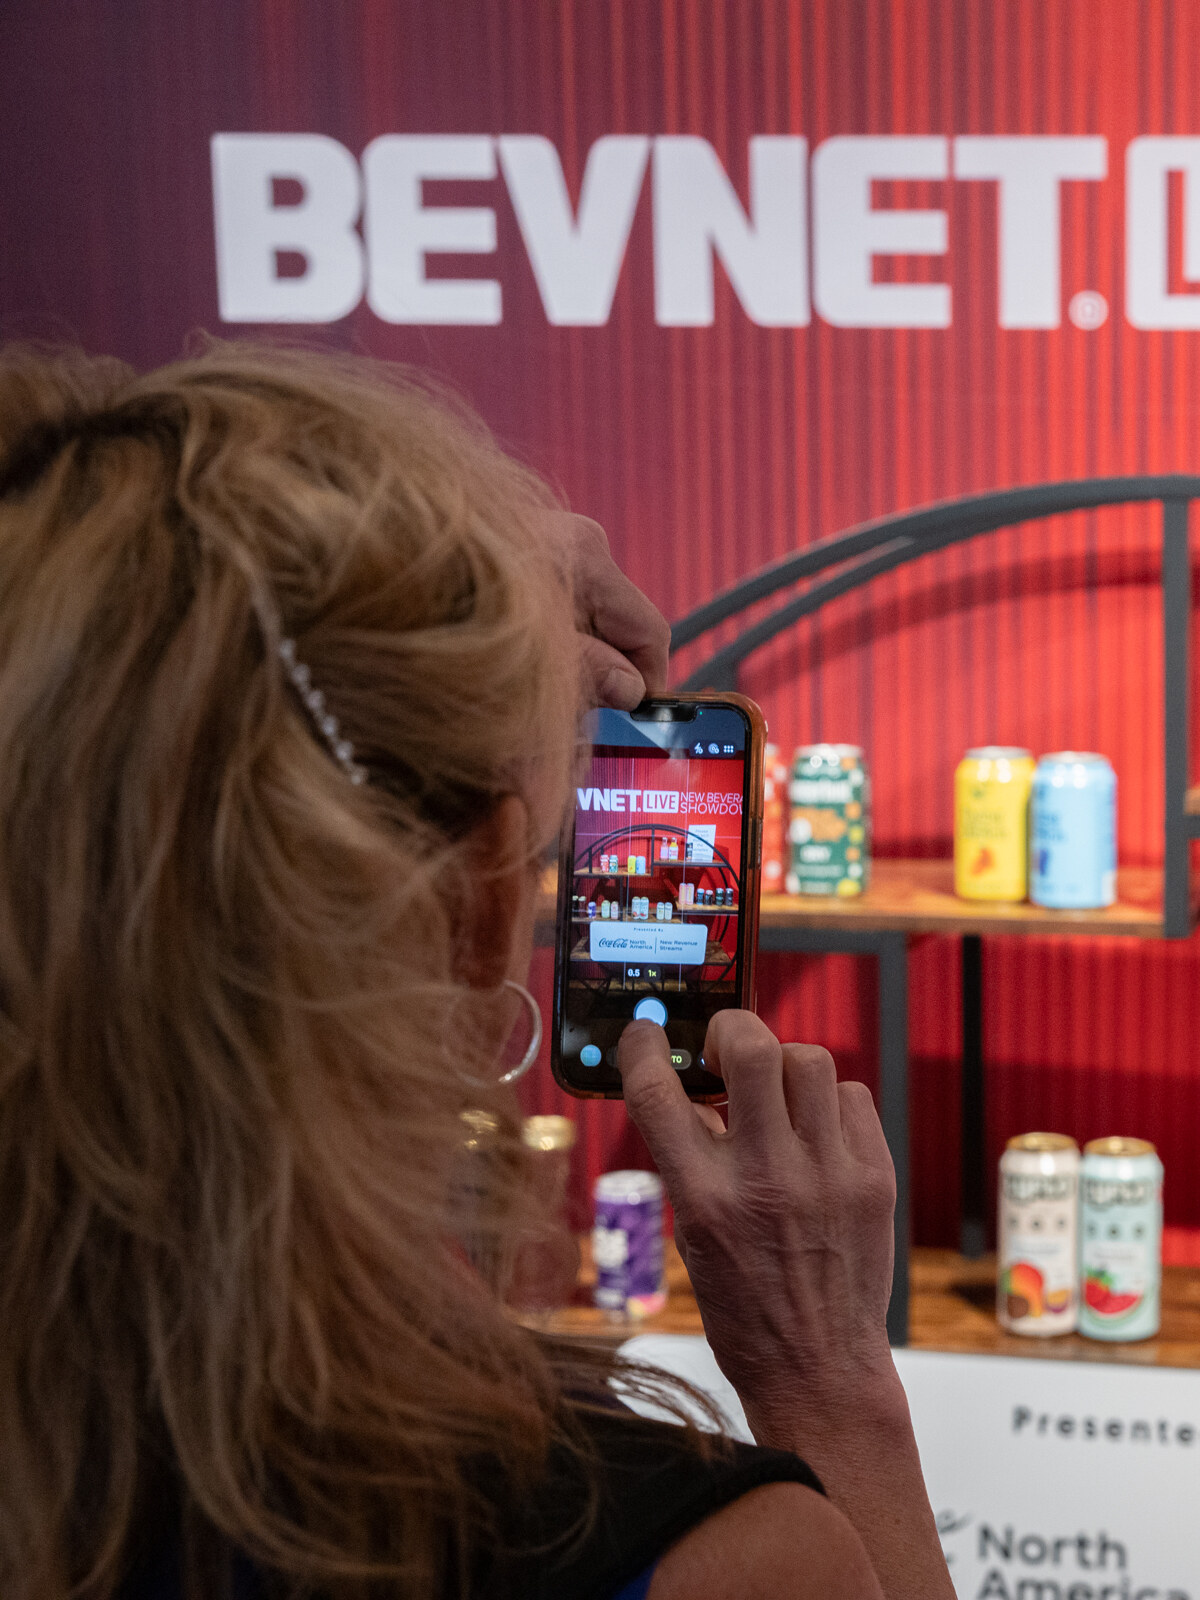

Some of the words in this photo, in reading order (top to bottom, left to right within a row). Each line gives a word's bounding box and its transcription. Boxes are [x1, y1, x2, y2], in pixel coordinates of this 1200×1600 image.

[646, 791, 677, 810] LIVE
[680, 791, 706, 803] NEW
[627, 968, 640, 977] 0.5
[648, 969, 657, 978] 1x
[977, 1525, 1128, 1569] North
